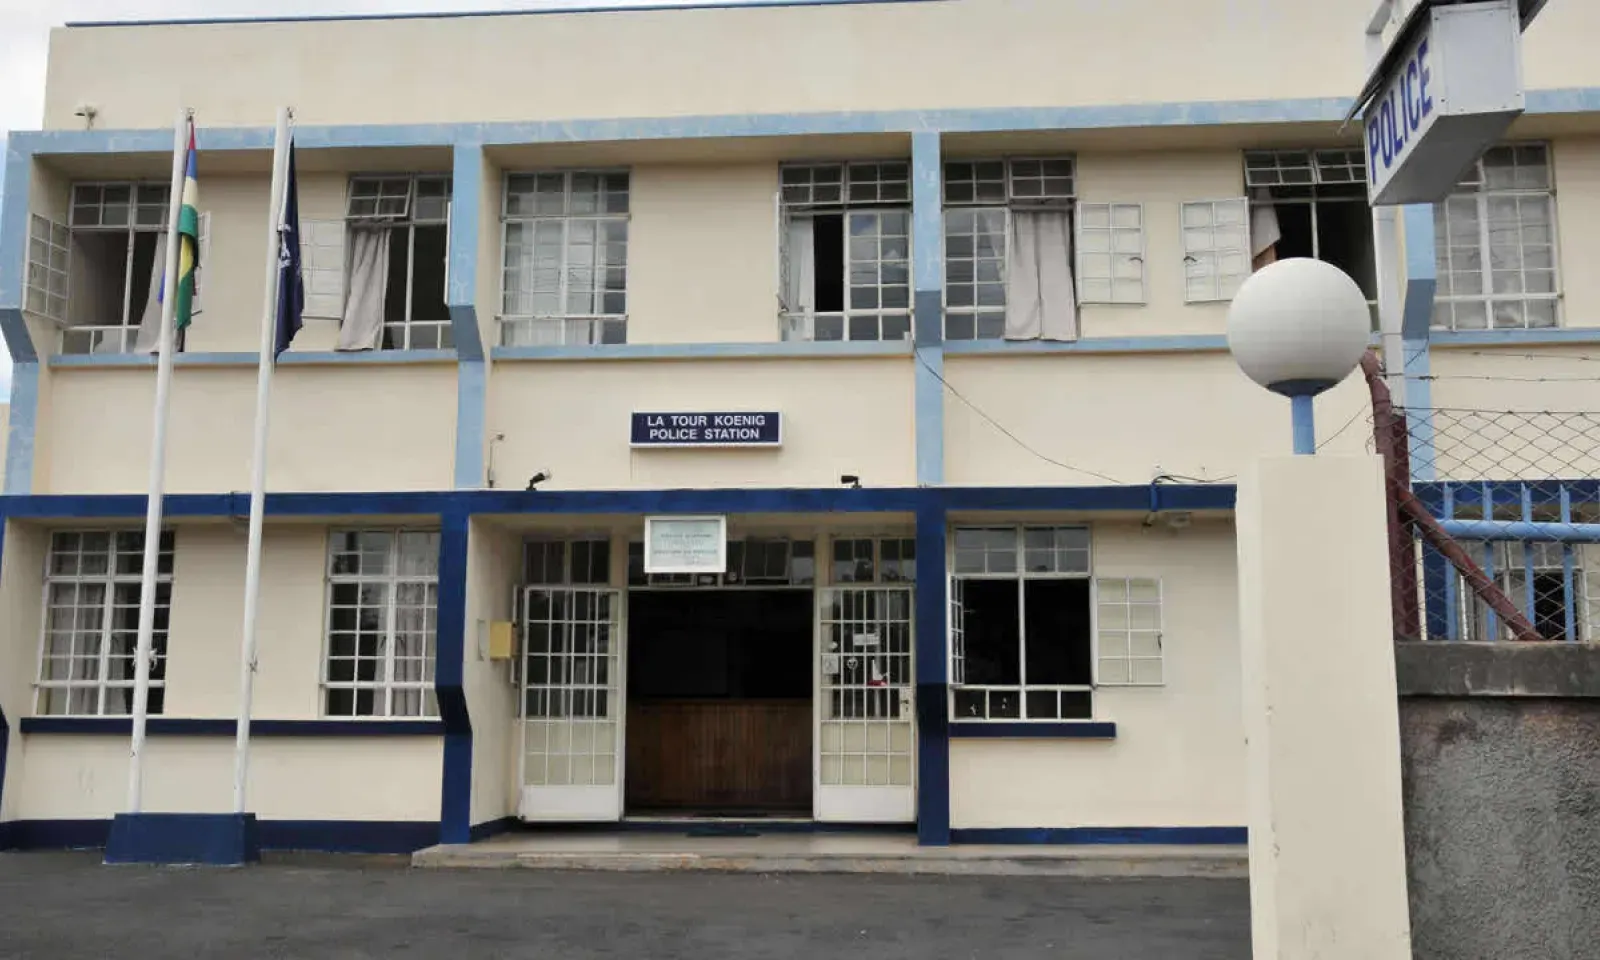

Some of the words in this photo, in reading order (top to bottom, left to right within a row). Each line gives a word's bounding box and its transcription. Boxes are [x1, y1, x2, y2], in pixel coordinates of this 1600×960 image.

[1368, 37, 1433, 185] POLICE
[647, 415, 664, 427] LA
[671, 415, 707, 427] TOUR
[714, 415, 766, 426] KOENIG
[649, 428, 698, 440] POLICE
[704, 428, 760, 440] STATION
